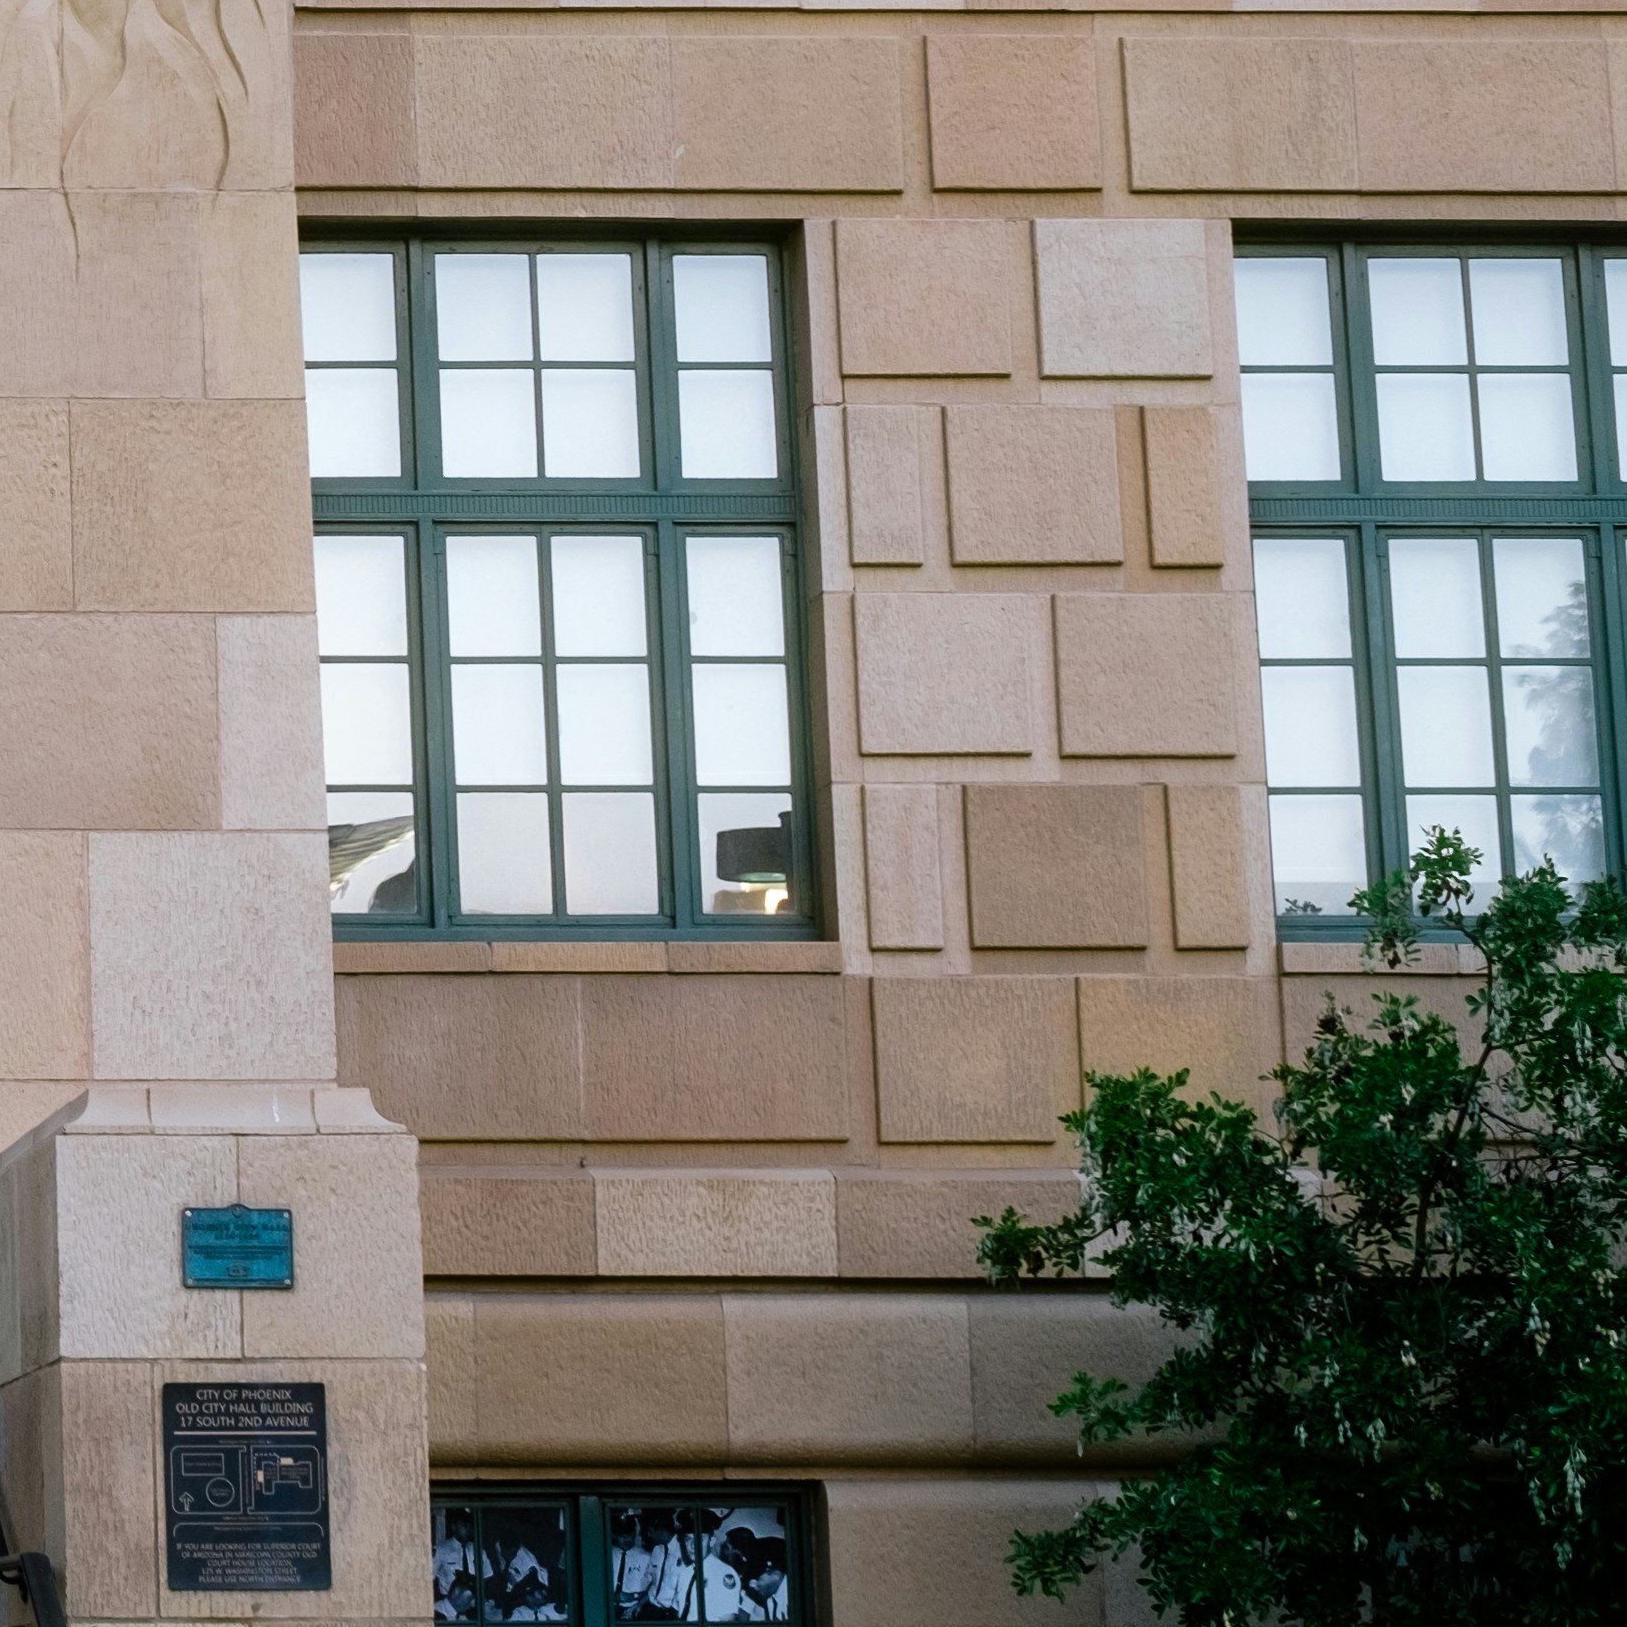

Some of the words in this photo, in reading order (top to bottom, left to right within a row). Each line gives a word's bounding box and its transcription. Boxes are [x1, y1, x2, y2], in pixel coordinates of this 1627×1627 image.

[196, 1390, 221, 1400] CITY
[223, 1390, 238, 1400] OF
[242, 1390, 292, 1400] PHOENIX
[175, 1403, 200, 1414] OLD
[202, 1403, 226, 1414] CITY
[230, 1403, 257, 1414] HALL
[260, 1403, 313, 1414] BUILDING
[180, 1417, 193, 1427] 17
[196, 1417, 235, 1427] SOUTH
[238, 1417, 262, 1427] 2ND
[265, 1417, 309, 1427] AVENUE
[198, 1575, 222, 1583] PLEASE
[224, 1575, 237, 1583] USE
